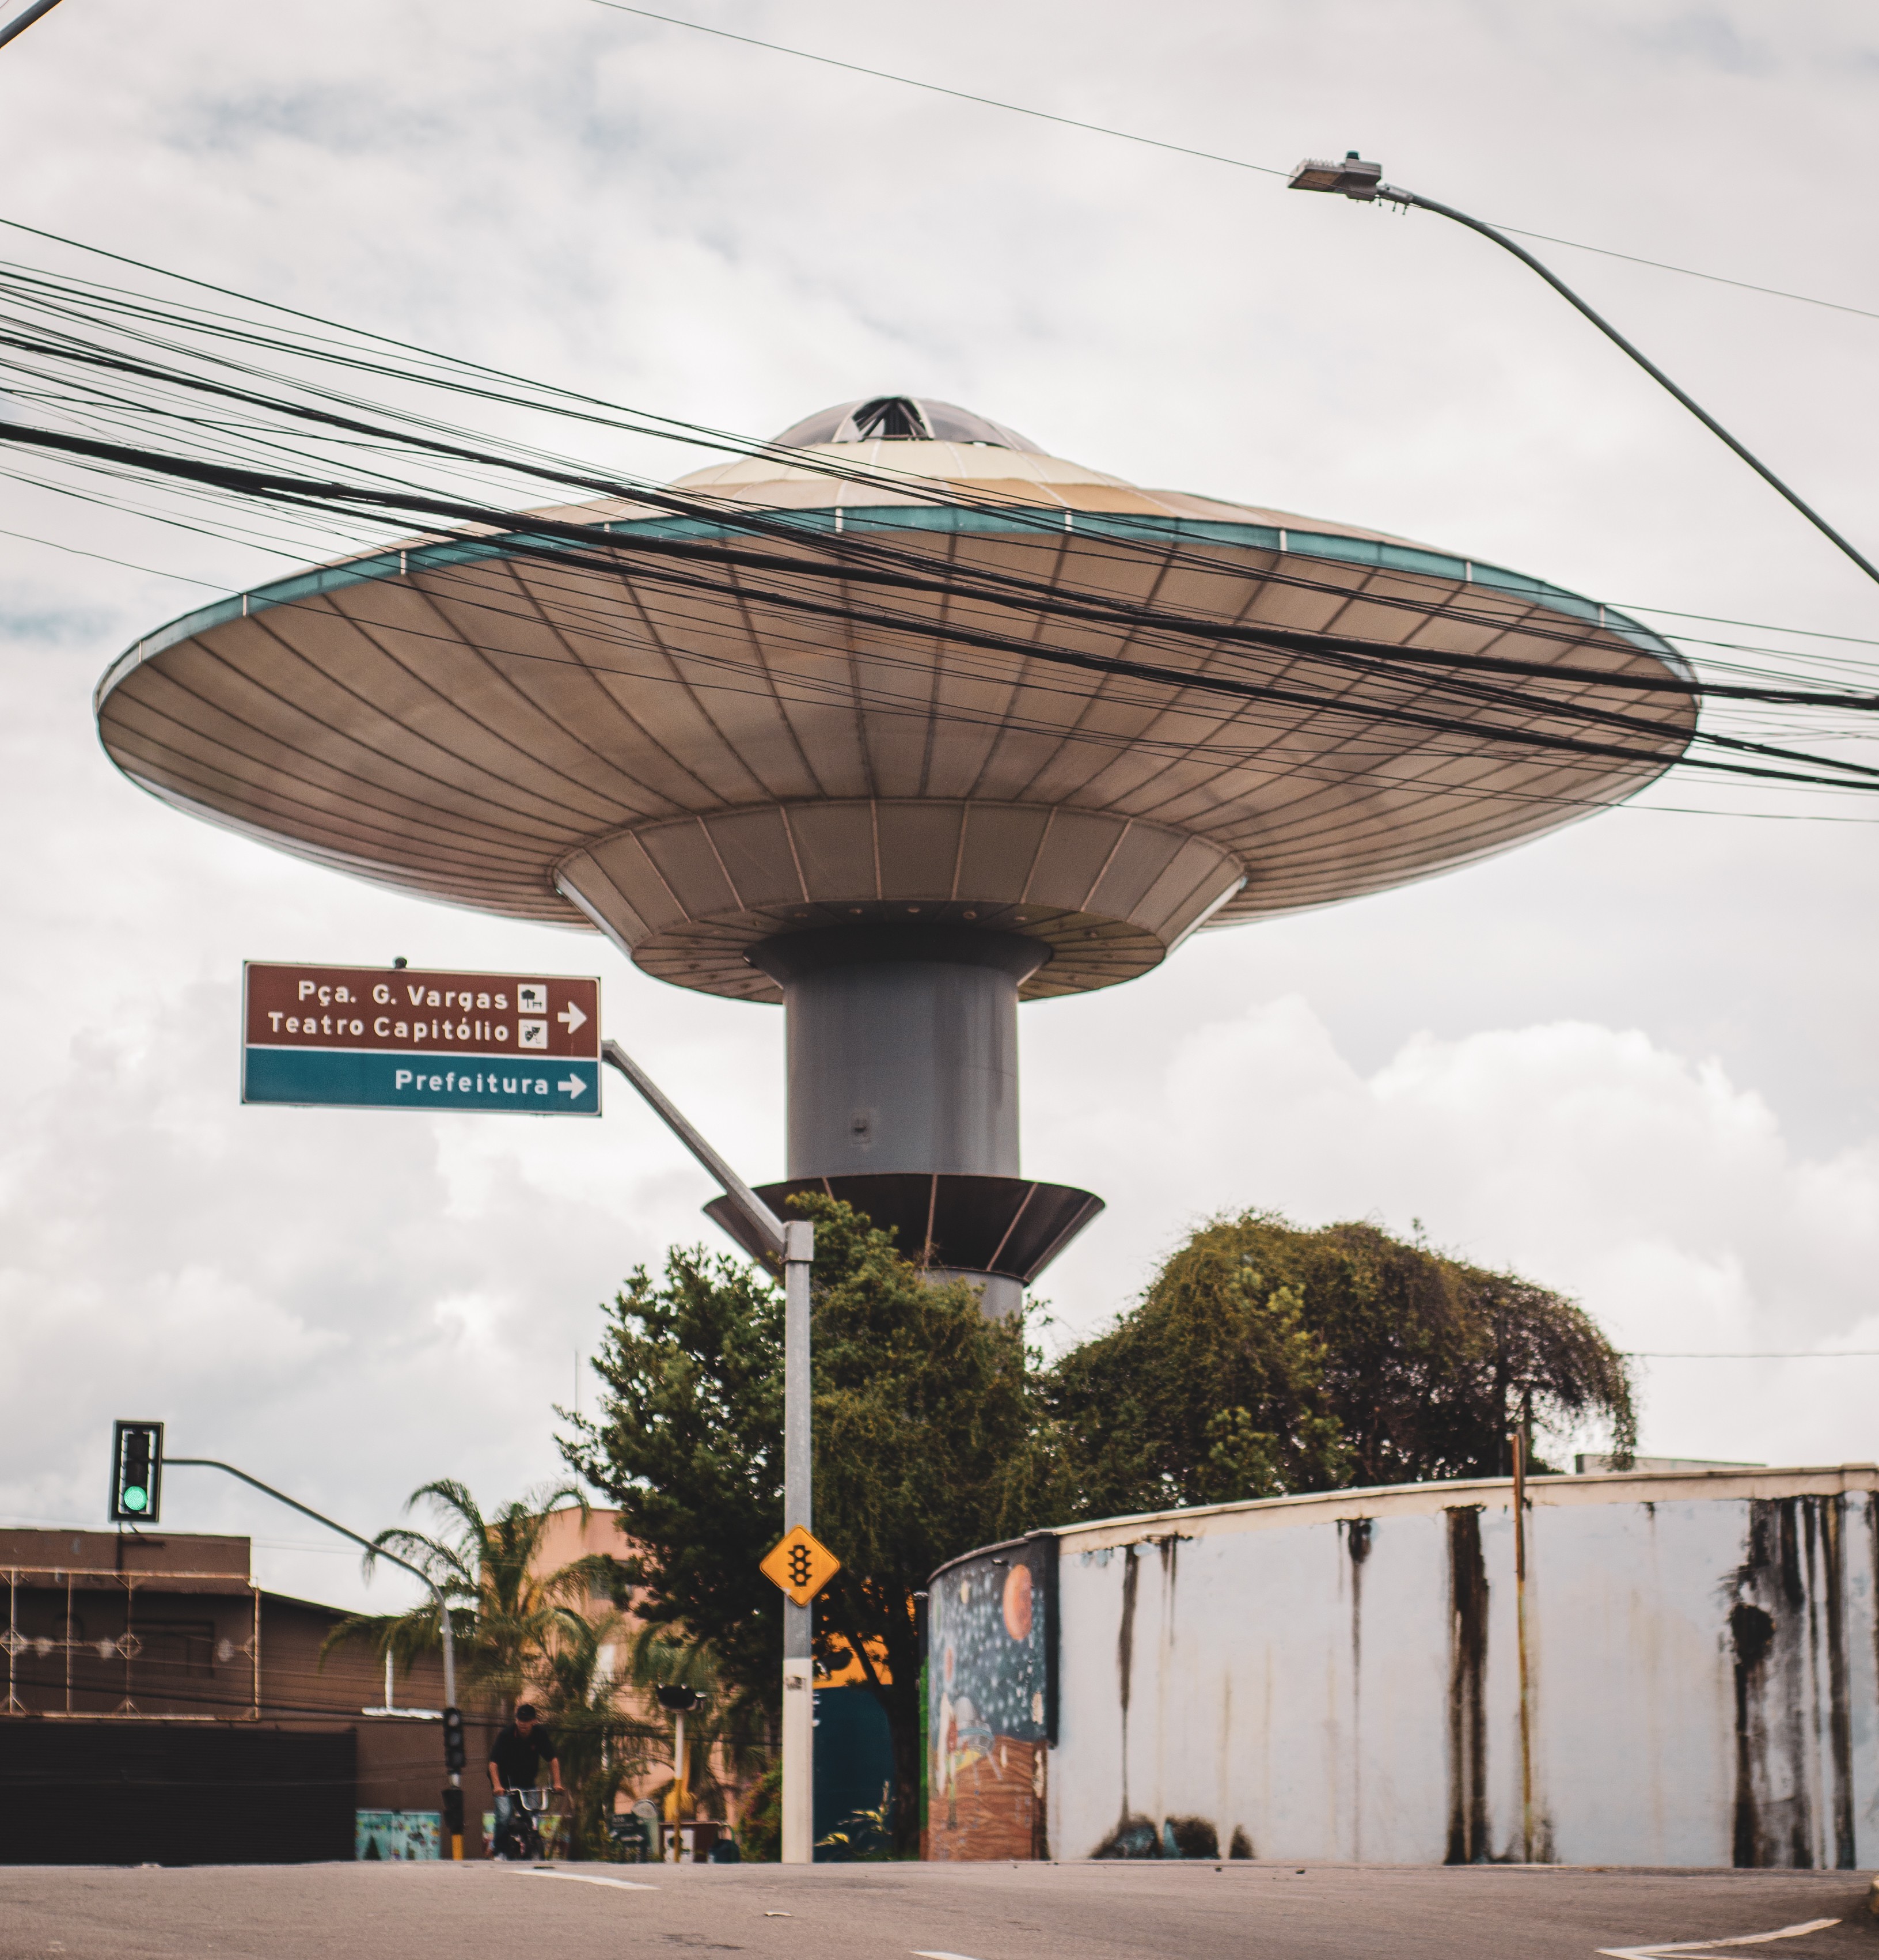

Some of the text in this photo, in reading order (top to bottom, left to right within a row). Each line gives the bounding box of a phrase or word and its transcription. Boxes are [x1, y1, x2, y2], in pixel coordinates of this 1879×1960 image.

[298, 980, 508, 1012] Pça. G. Vargas
[268, 1011, 509, 1042] Teatro Capitólio
[396, 1070, 548, 1095] Prefeitura
